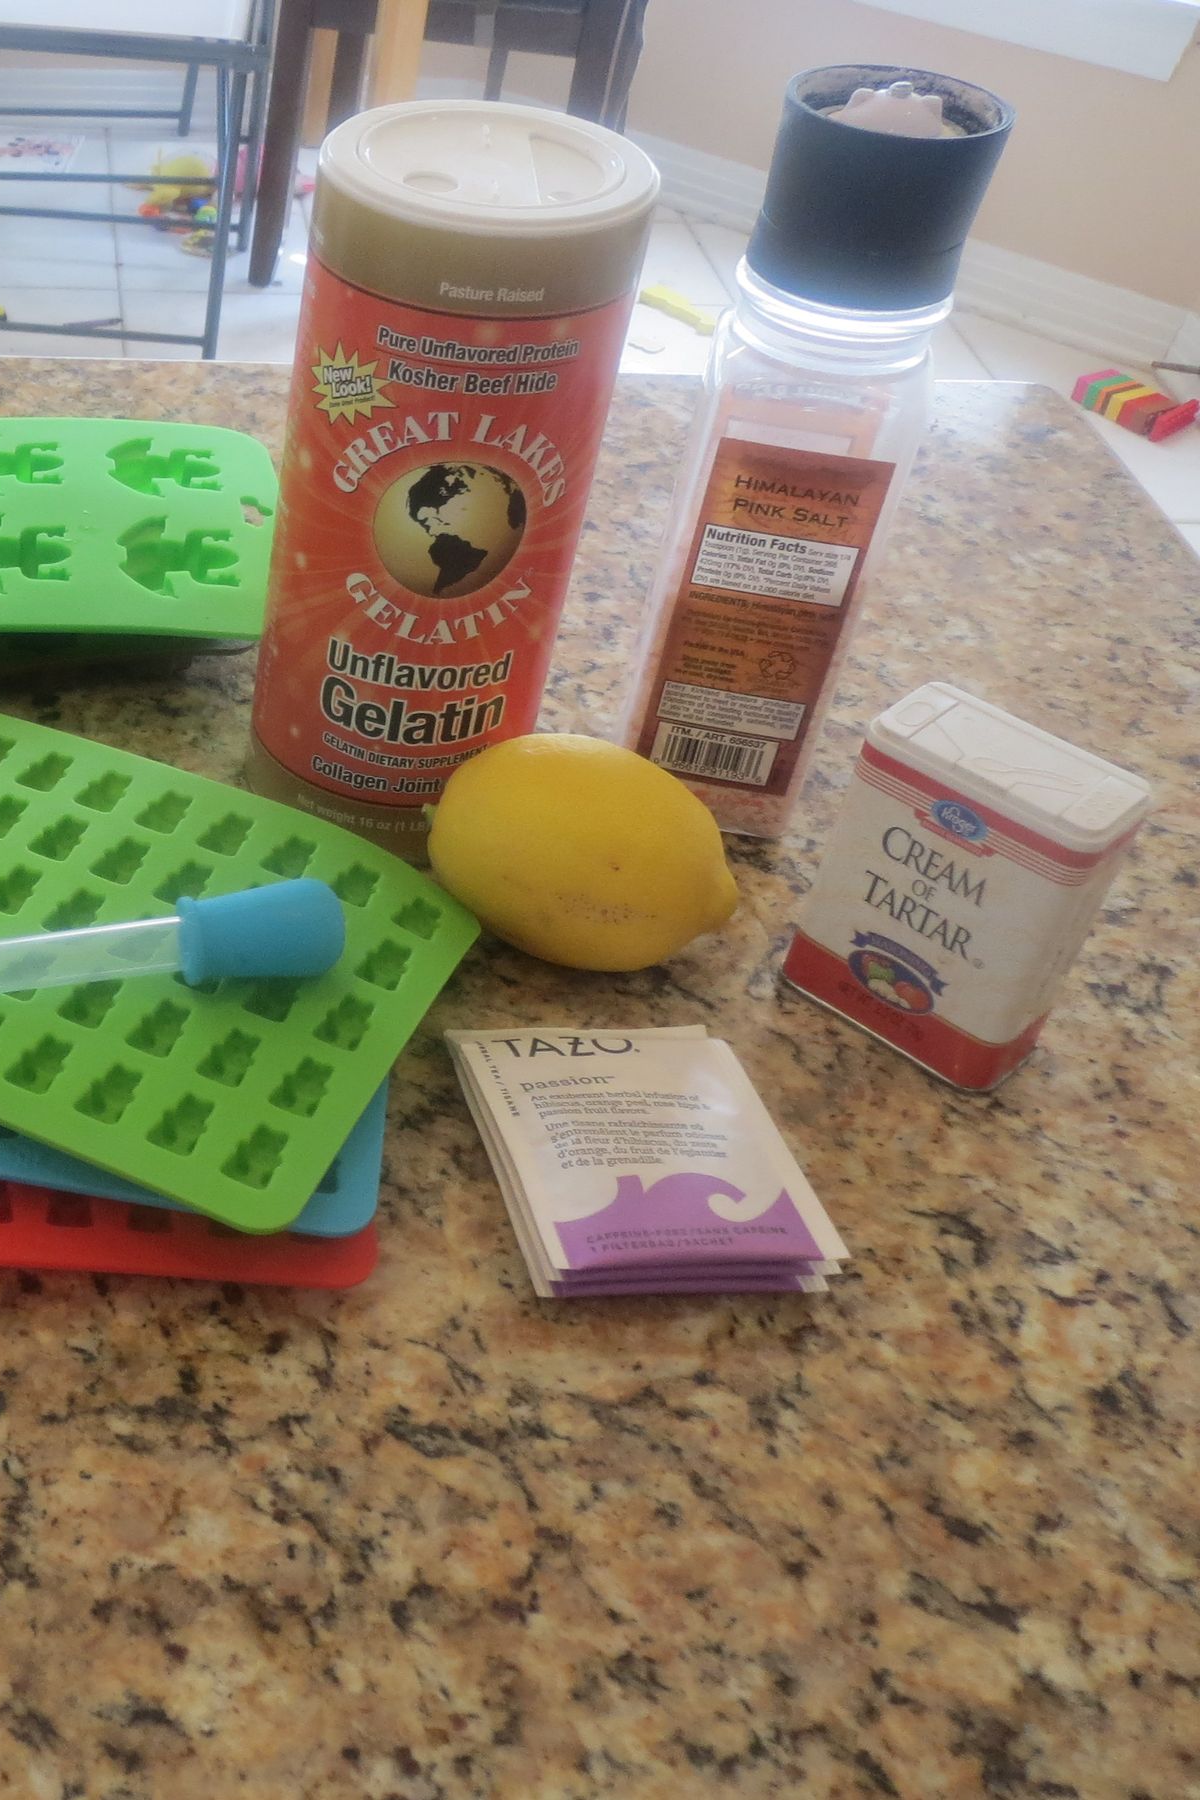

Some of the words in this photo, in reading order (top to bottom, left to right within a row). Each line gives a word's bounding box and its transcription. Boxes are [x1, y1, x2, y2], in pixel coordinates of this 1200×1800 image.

[440, 281, 494, 301] Pasture
[497, 287, 545, 301] Raised
[377, 325, 417, 352] Pure
[420, 336, 519, 364] Unflavored
[520, 341, 580, 363] Protein
[323, 365, 354, 385] New
[332, 375, 372, 398] Look!
[388, 359, 460, 392] Kosher
[463, 372, 511, 395] Beef
[514, 371, 557, 394] Hide
[333, 412, 460, 493] GREAT
[469, 413, 566, 507] LAKES
[734, 474, 860, 508] HIMALAYAN
[732, 497, 784, 520] PINK
[792, 508, 850, 529] SALT
[706, 527, 768, 548] Nutrition
[769, 537, 808, 554] Facts
[345, 572, 534, 645] GELATIN
[326, 636, 514, 692] Unflavored
[320, 675, 507, 747] Gelatin
[322, 731, 365, 760] GELATIN
[367, 752, 415, 770] DIETARY
[417, 744, 489, 769] SUPPLEMENT
[671, 725, 695, 737] ITM.
[703, 731, 727, 743] ART.
[312, 755, 388, 791] Collagen
[392, 777, 441, 794] Joint
[317, 805, 355, 826] weight
[359, 816, 374, 827] 16
[377, 820, 391, 830] oz
[941, 805, 977, 833] Kroger
[882, 826, 987, 907] CREAM
[911, 879, 938, 902] OF
[864, 870, 969, 960] TARTAR
[520, 1077, 610, 1093] passion
[575, 1157, 590, 1167] de
